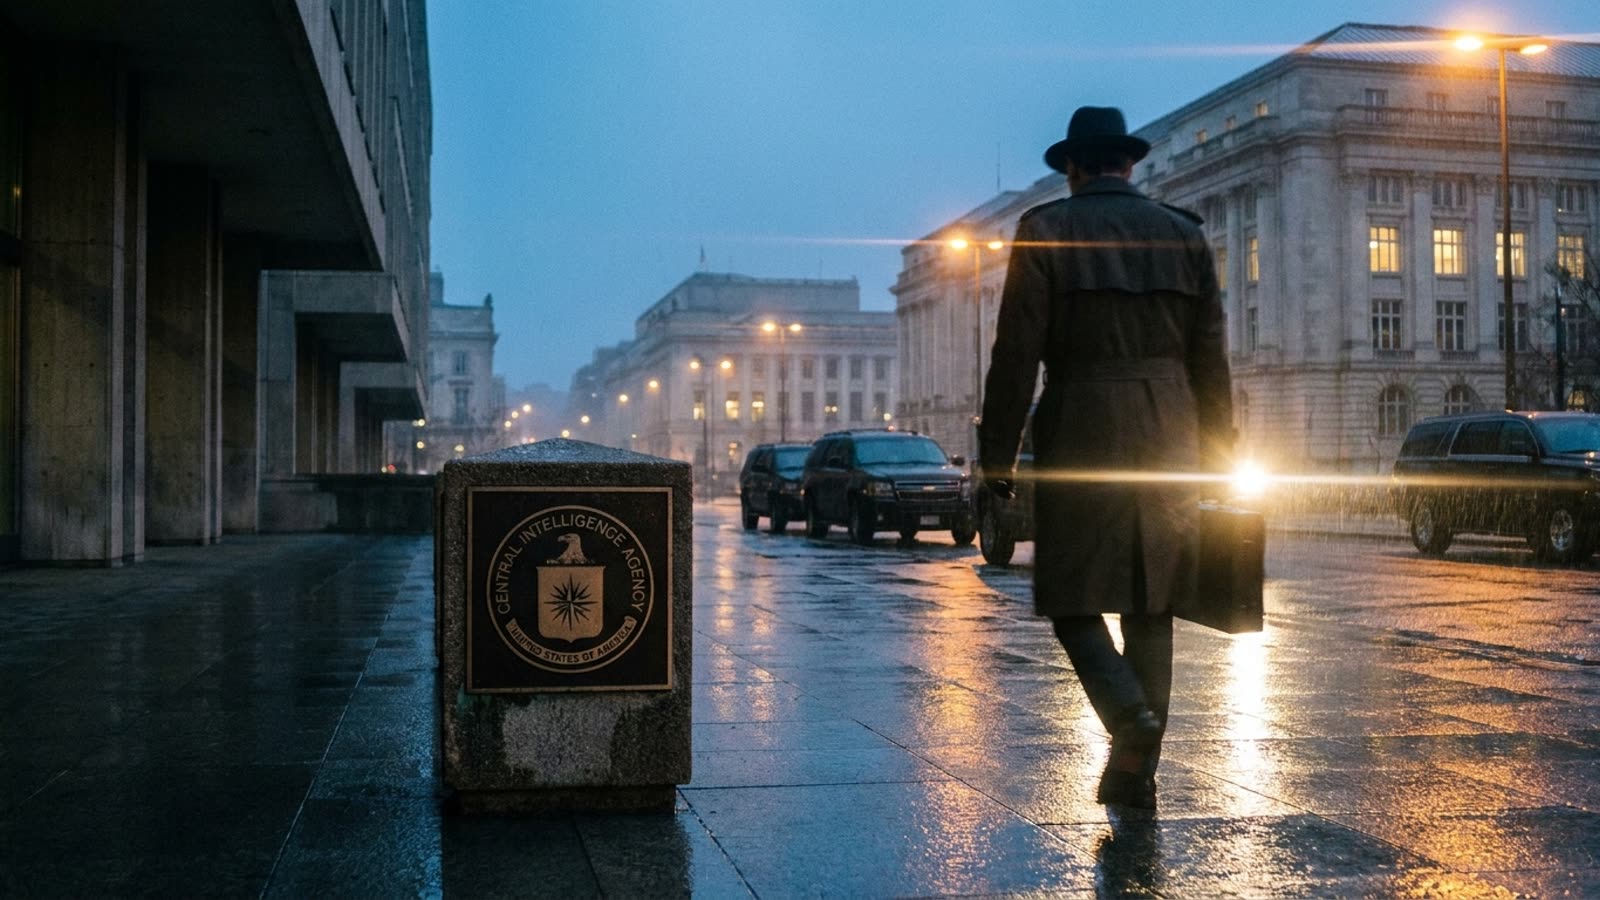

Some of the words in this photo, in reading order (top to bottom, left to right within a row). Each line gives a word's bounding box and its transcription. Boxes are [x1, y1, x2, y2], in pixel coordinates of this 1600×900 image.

[495, 547, 523, 614] CENTRAL
[519, 514, 626, 548] INTELLIGENCE
[621, 548, 646, 613] AGENCY
[543, 650, 580, 663] STATES
[582, 650, 595, 662] OF
